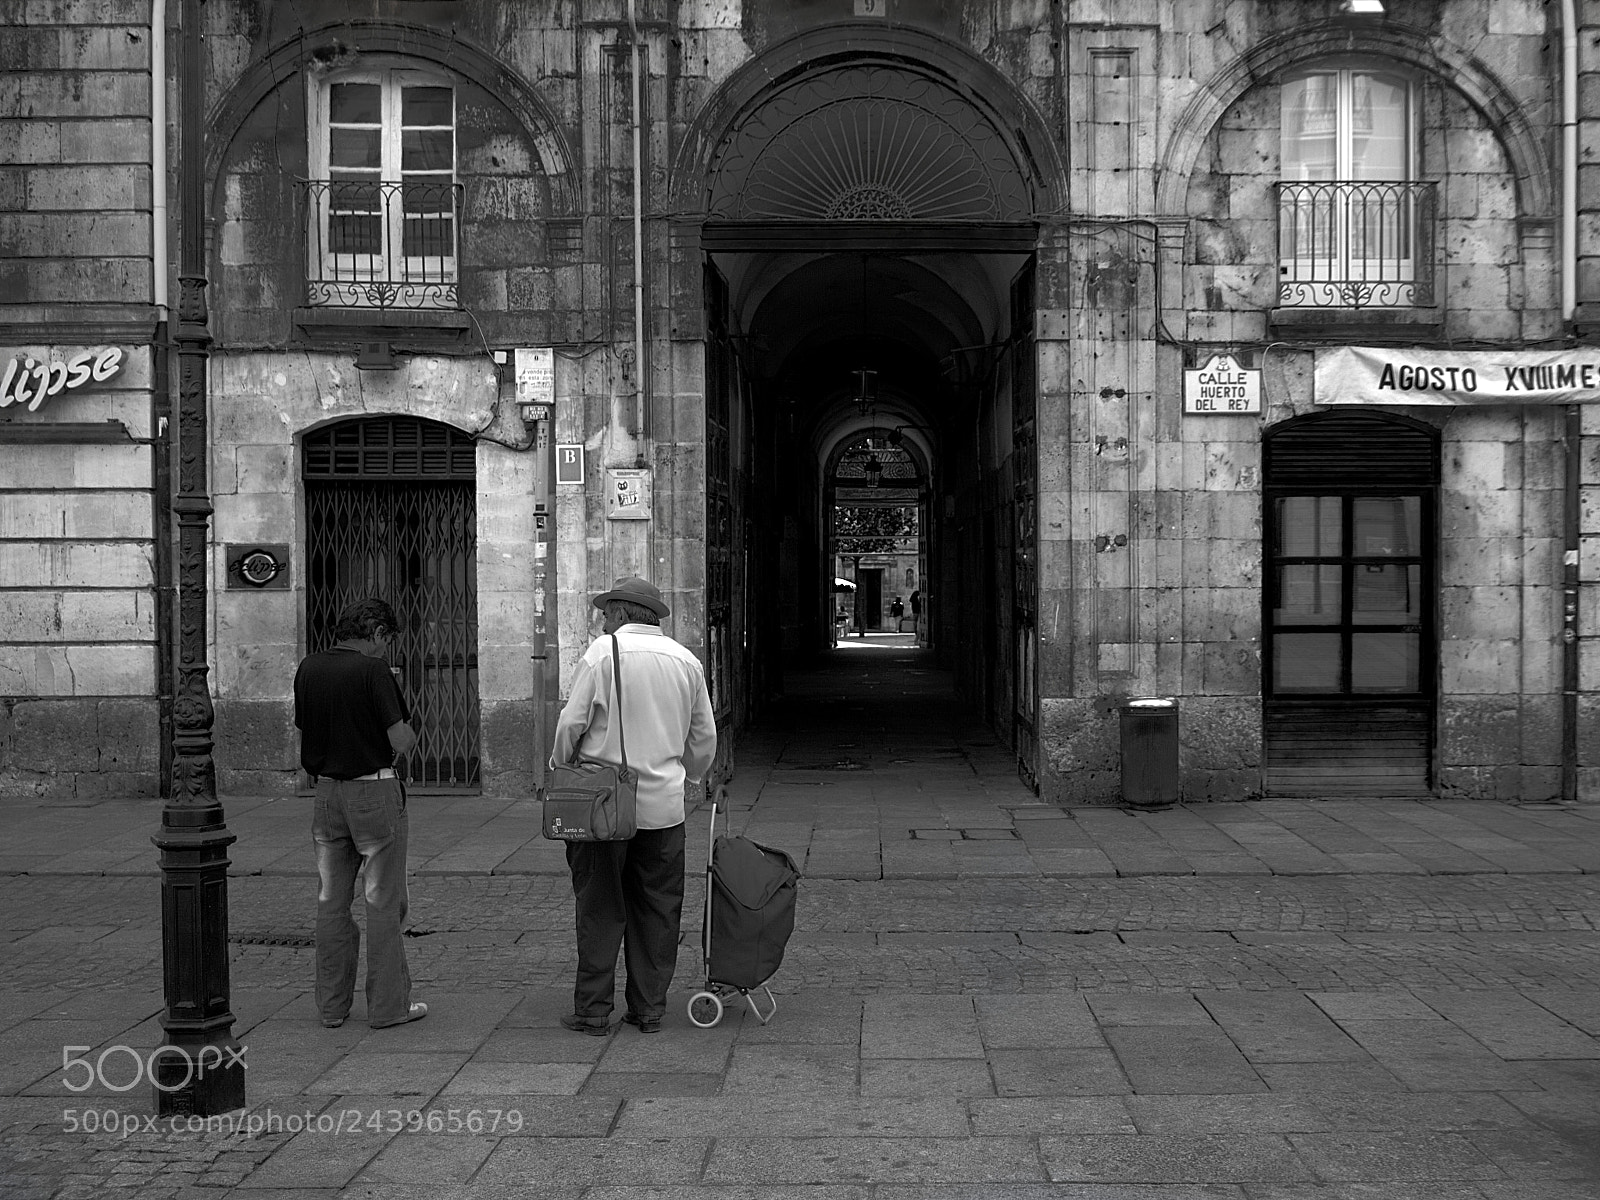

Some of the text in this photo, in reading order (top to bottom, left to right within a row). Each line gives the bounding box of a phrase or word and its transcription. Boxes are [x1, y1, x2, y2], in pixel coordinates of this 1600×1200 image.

[0, 347, 122, 411] lipse
[1198, 372, 1247, 385] CALLE
[1378, 363, 1478, 392] AGOSTO
[1201, 386, 1245, 398] HUERTO
[1196, 398, 1250, 411] DEL REY
[564, 449, 576, 464] B
